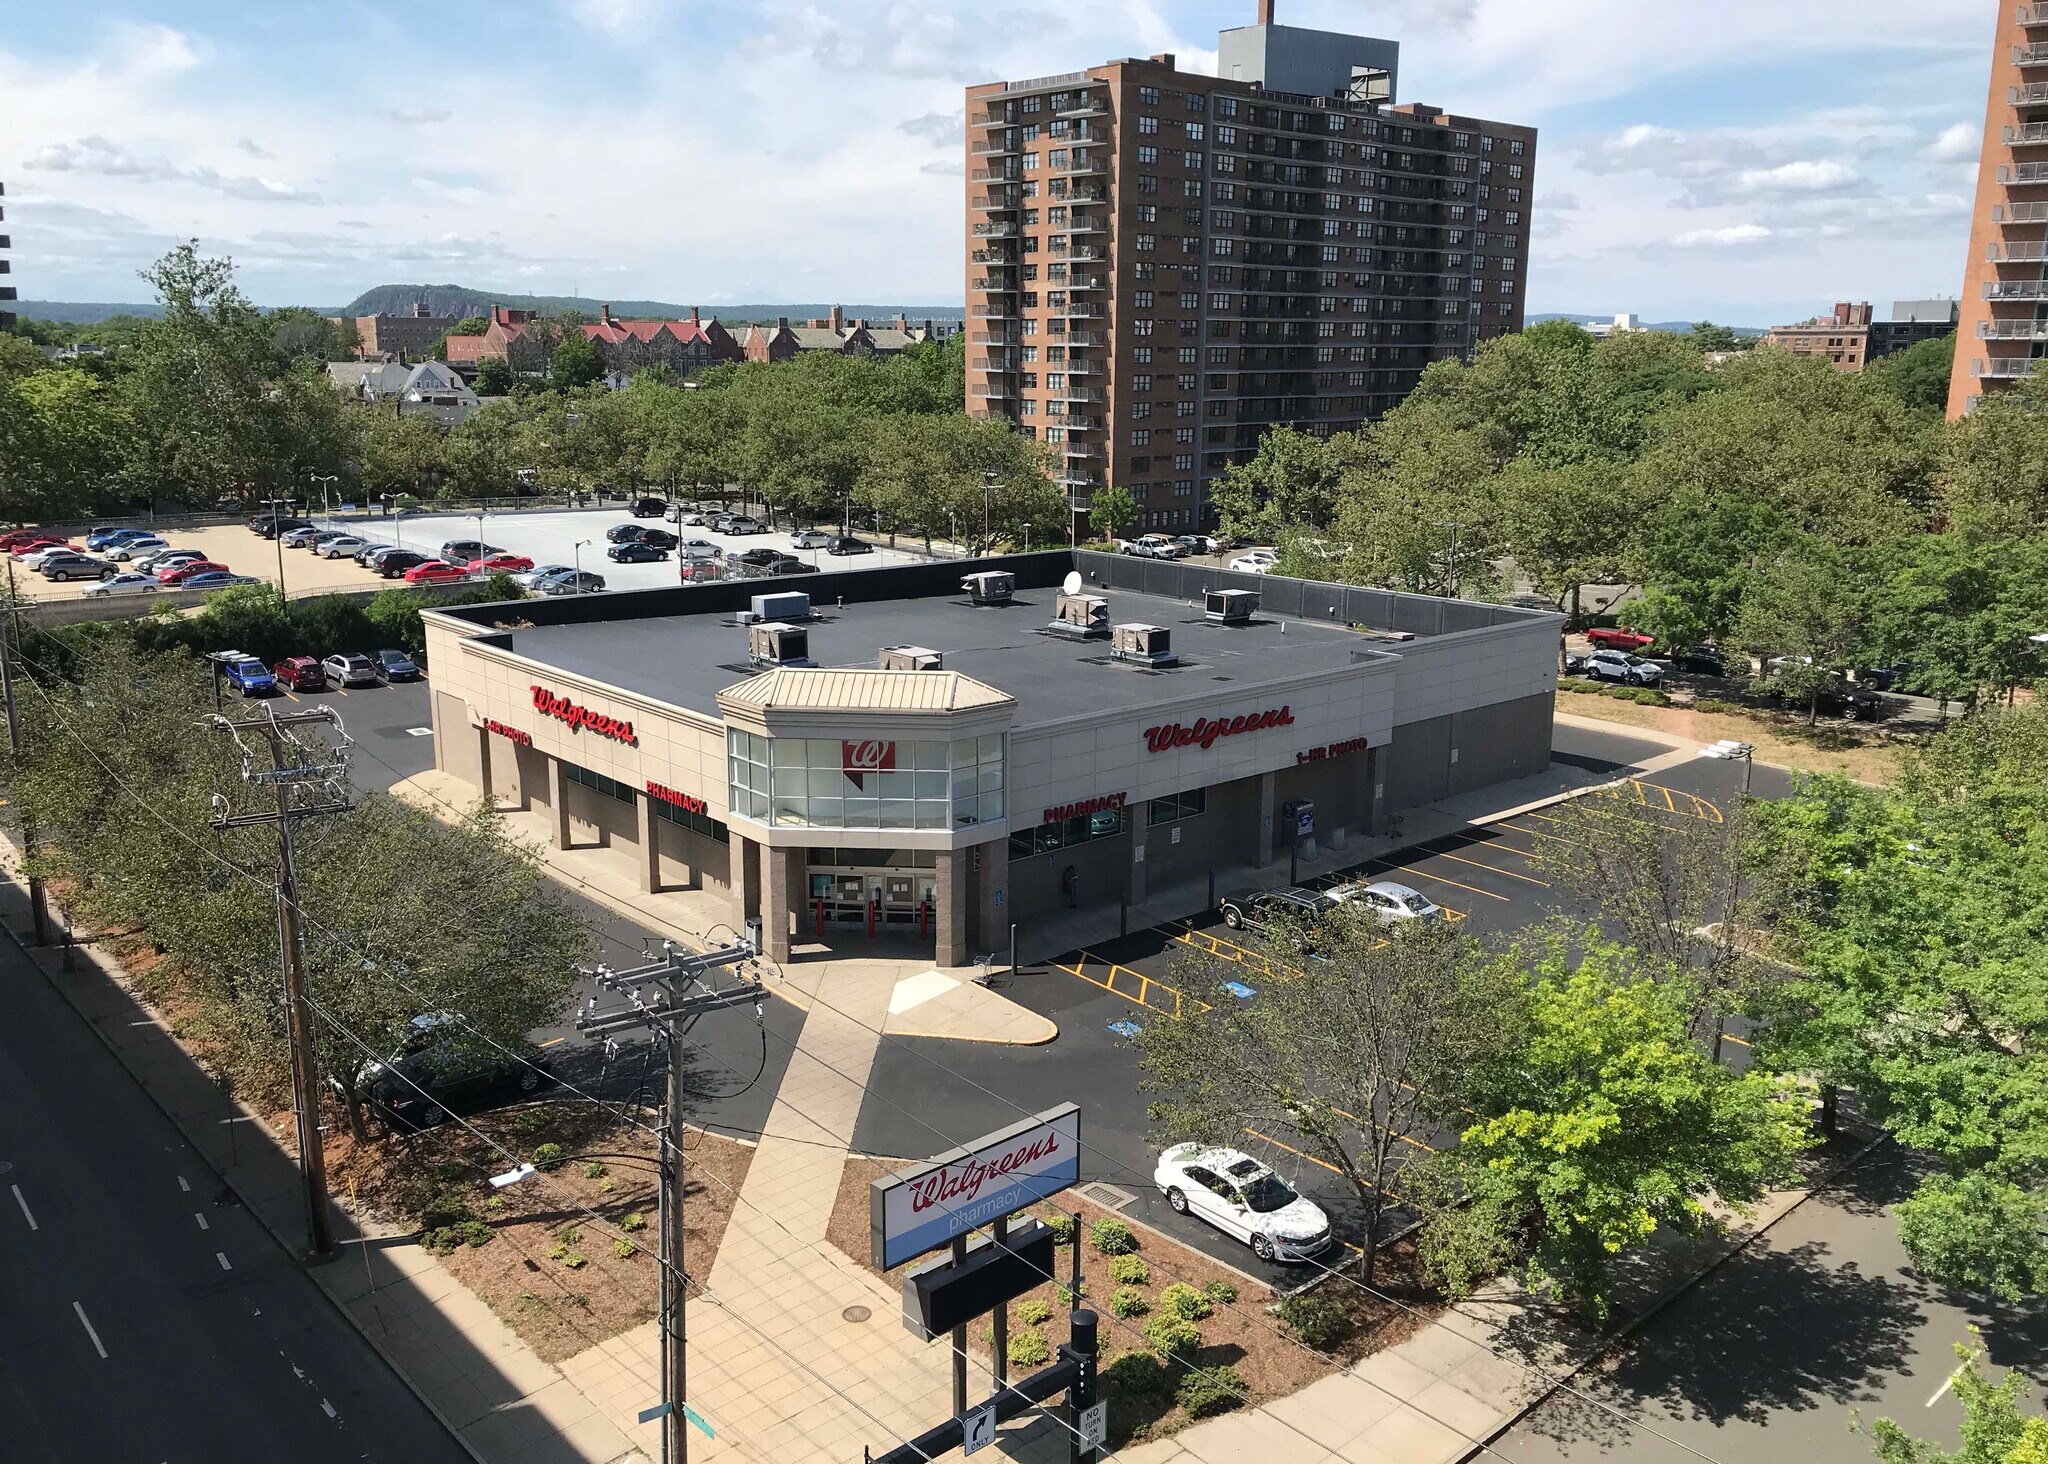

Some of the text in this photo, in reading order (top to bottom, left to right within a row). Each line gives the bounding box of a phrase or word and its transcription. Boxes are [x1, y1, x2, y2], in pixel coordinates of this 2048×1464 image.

[530, 685, 639, 743] Walgreens
[502, 724, 531, 746] PHOTO
[1143, 705, 1295, 753] Walgreens
[1329, 737, 1368, 759] PHOTO
[645, 779, 706, 815] PHARMACY
[1043, 791, 1128, 824] PHARMACY
[909, 1132, 1060, 1213] Walgreens
[949, 1188, 1021, 1235] pharmacy
[1084, 1416, 1102, 1430] TURN
[1086, 1407, 1099, 1421] NO
[970, 1435, 990, 1451] ONLY
[1088, 1426, 1098, 1437] ON
